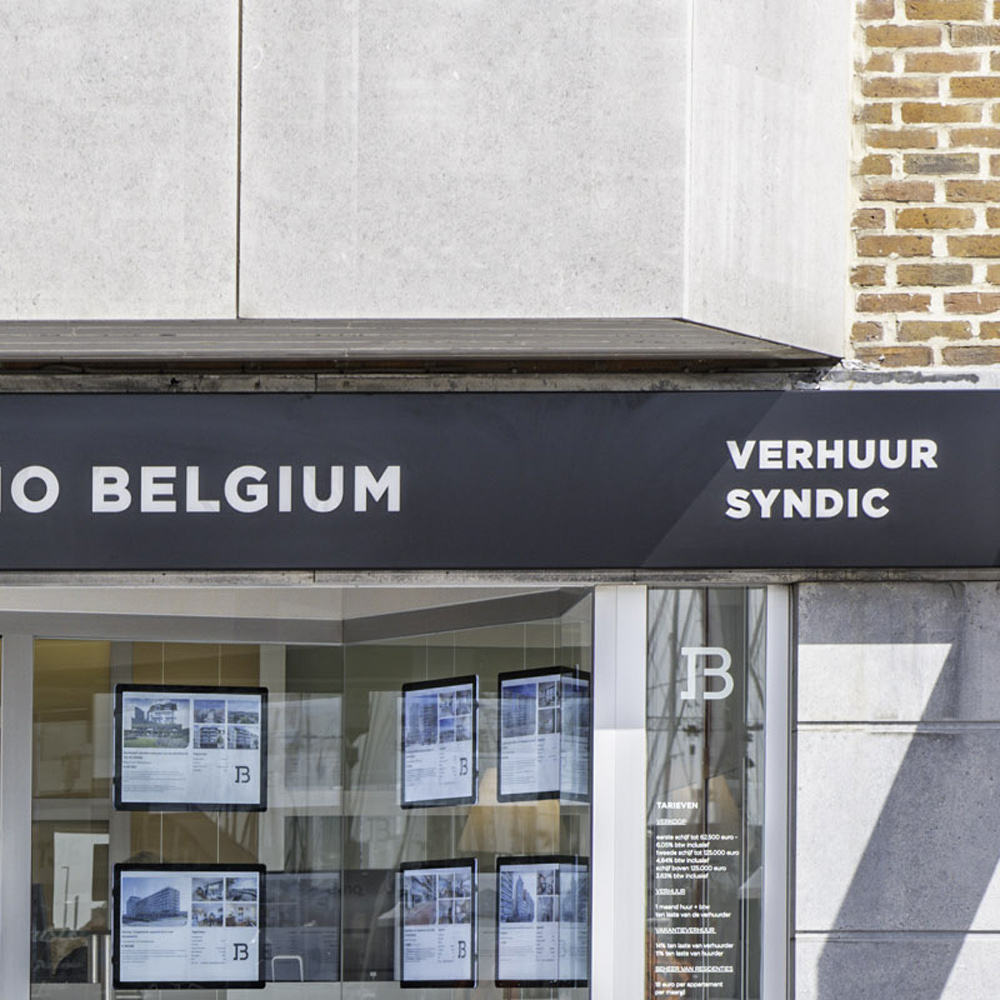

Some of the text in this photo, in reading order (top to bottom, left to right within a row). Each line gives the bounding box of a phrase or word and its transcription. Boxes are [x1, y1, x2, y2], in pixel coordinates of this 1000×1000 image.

[726, 439, 939, 470] VERHUUR
[92, 465, 401, 514] BELGIUM
[725, 488, 890, 519] SYNDIC
